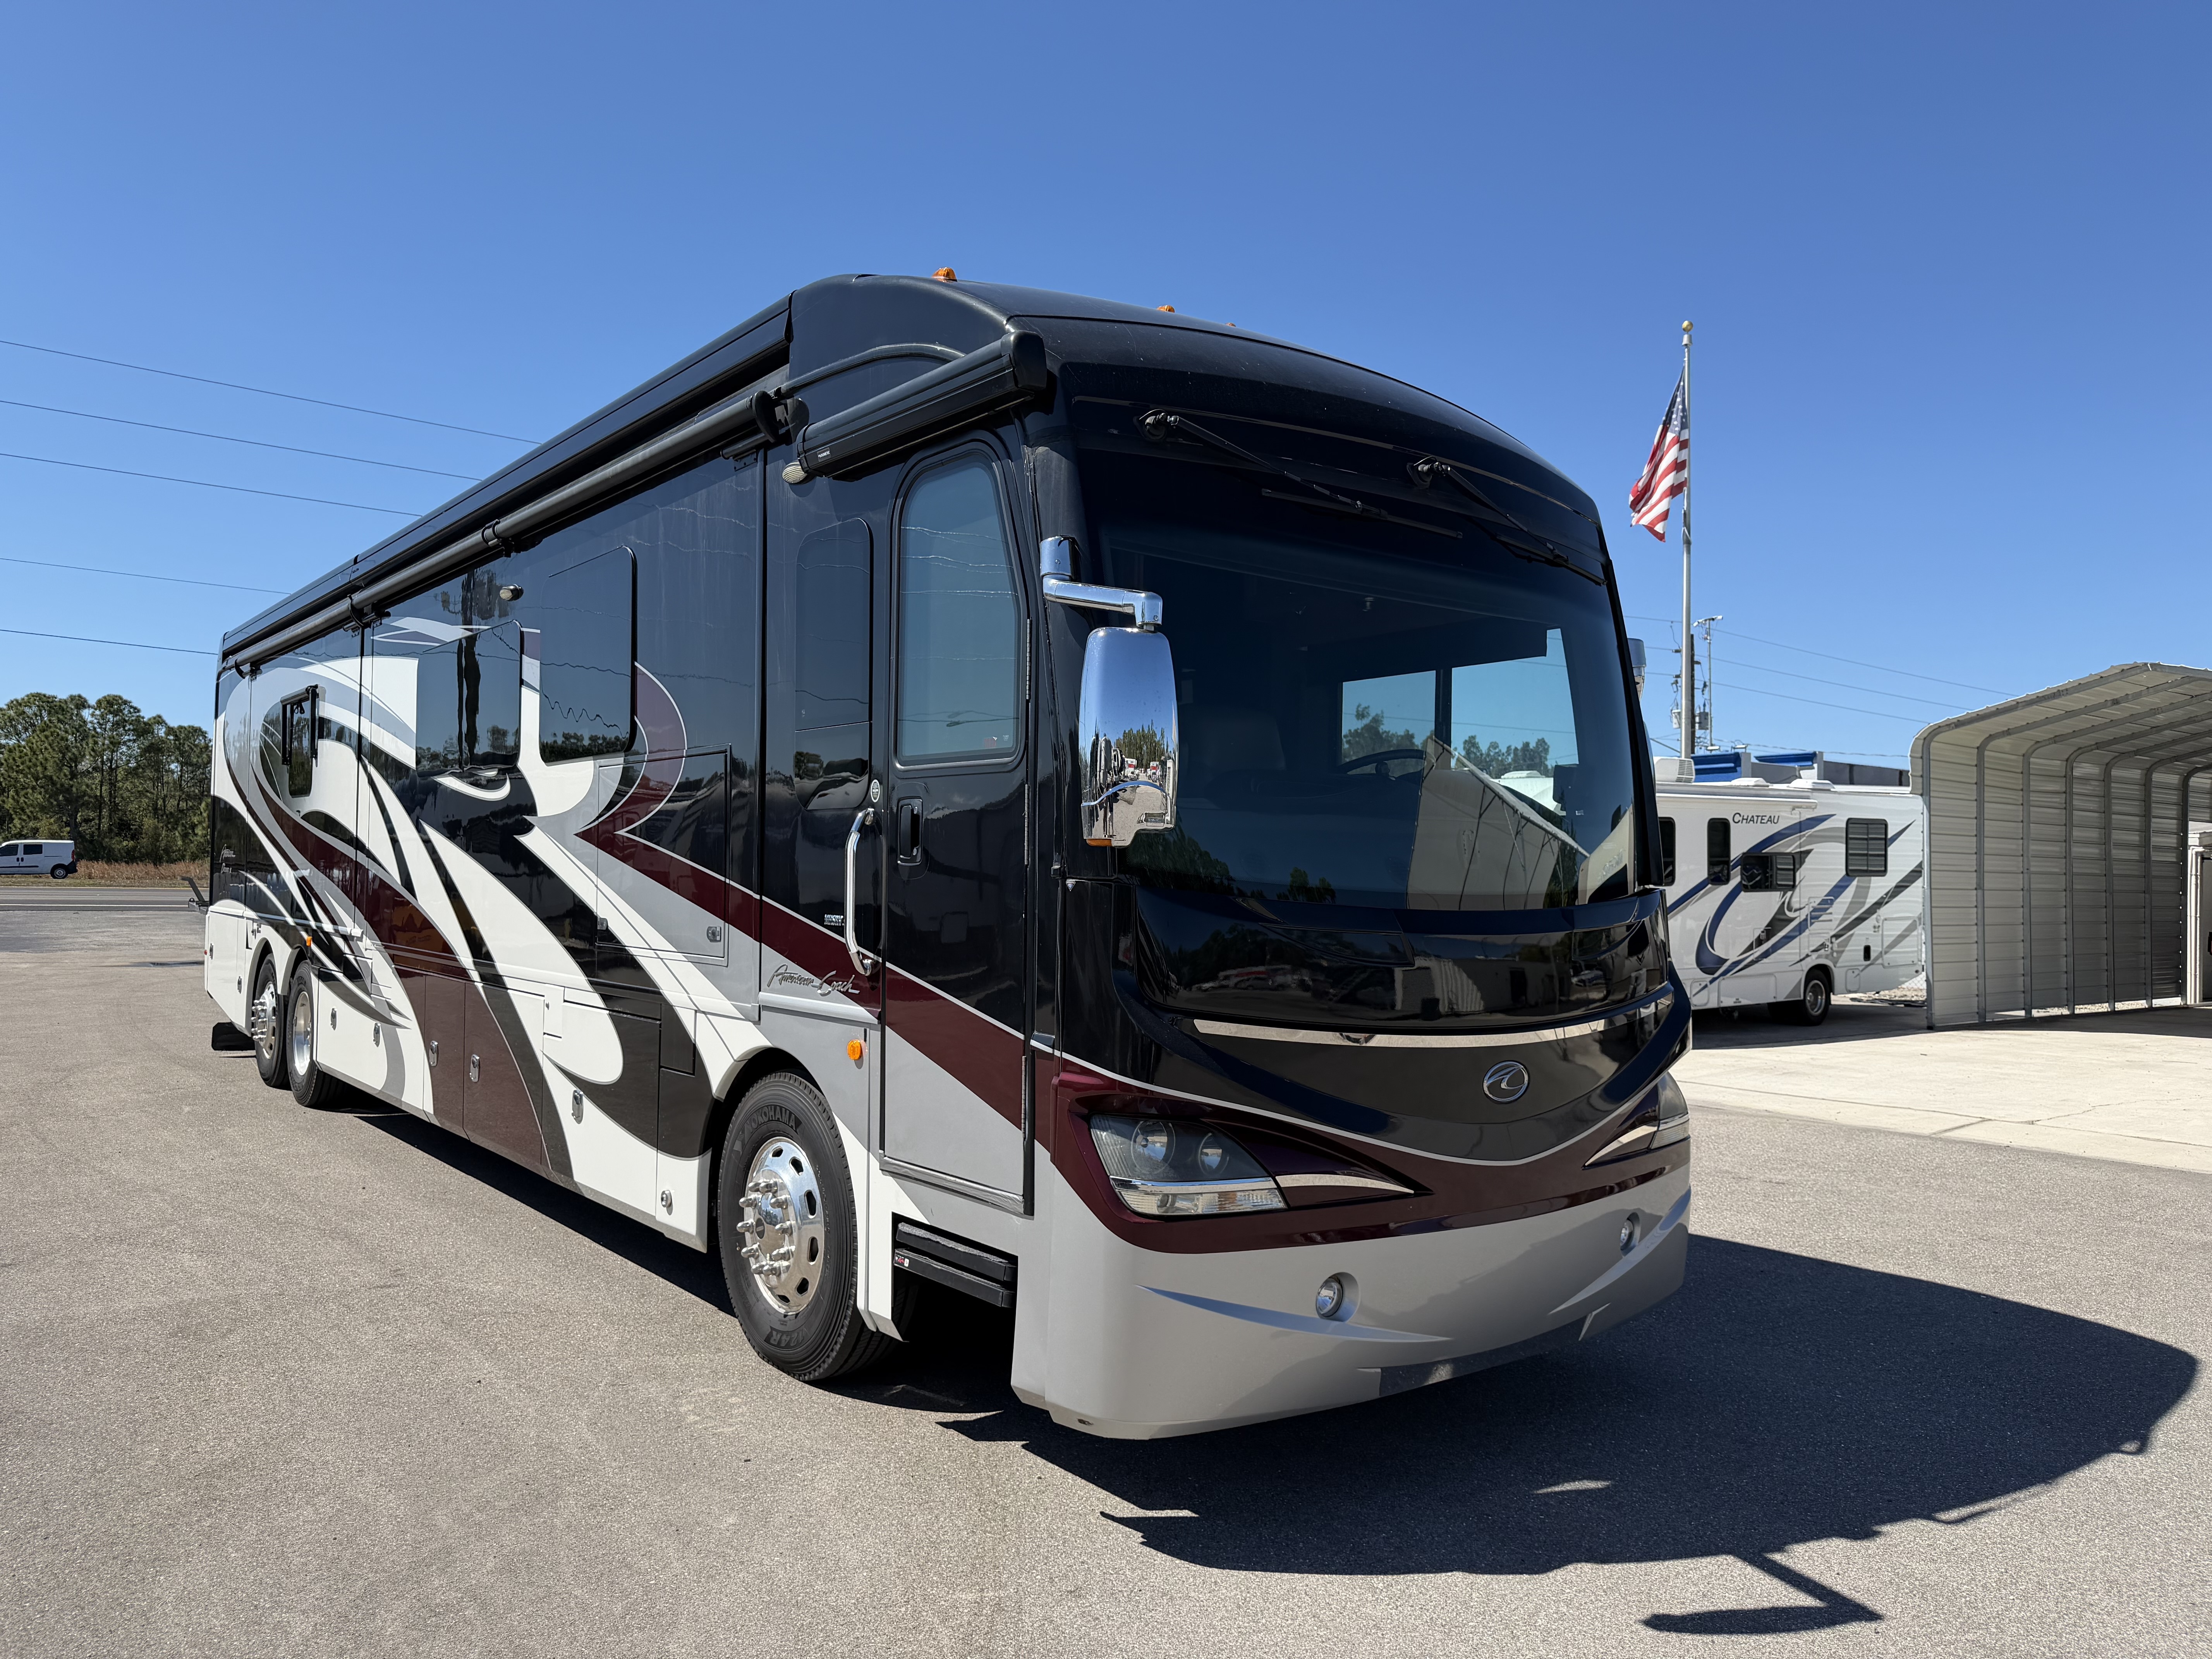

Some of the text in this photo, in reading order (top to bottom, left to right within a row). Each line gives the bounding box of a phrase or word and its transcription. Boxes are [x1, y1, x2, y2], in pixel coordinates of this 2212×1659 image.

[1732, 812, 1780, 824] CHATEAU
[817, 970, 860, 994] Coach
[744, 1106, 796, 1133] YOKOHAMA
